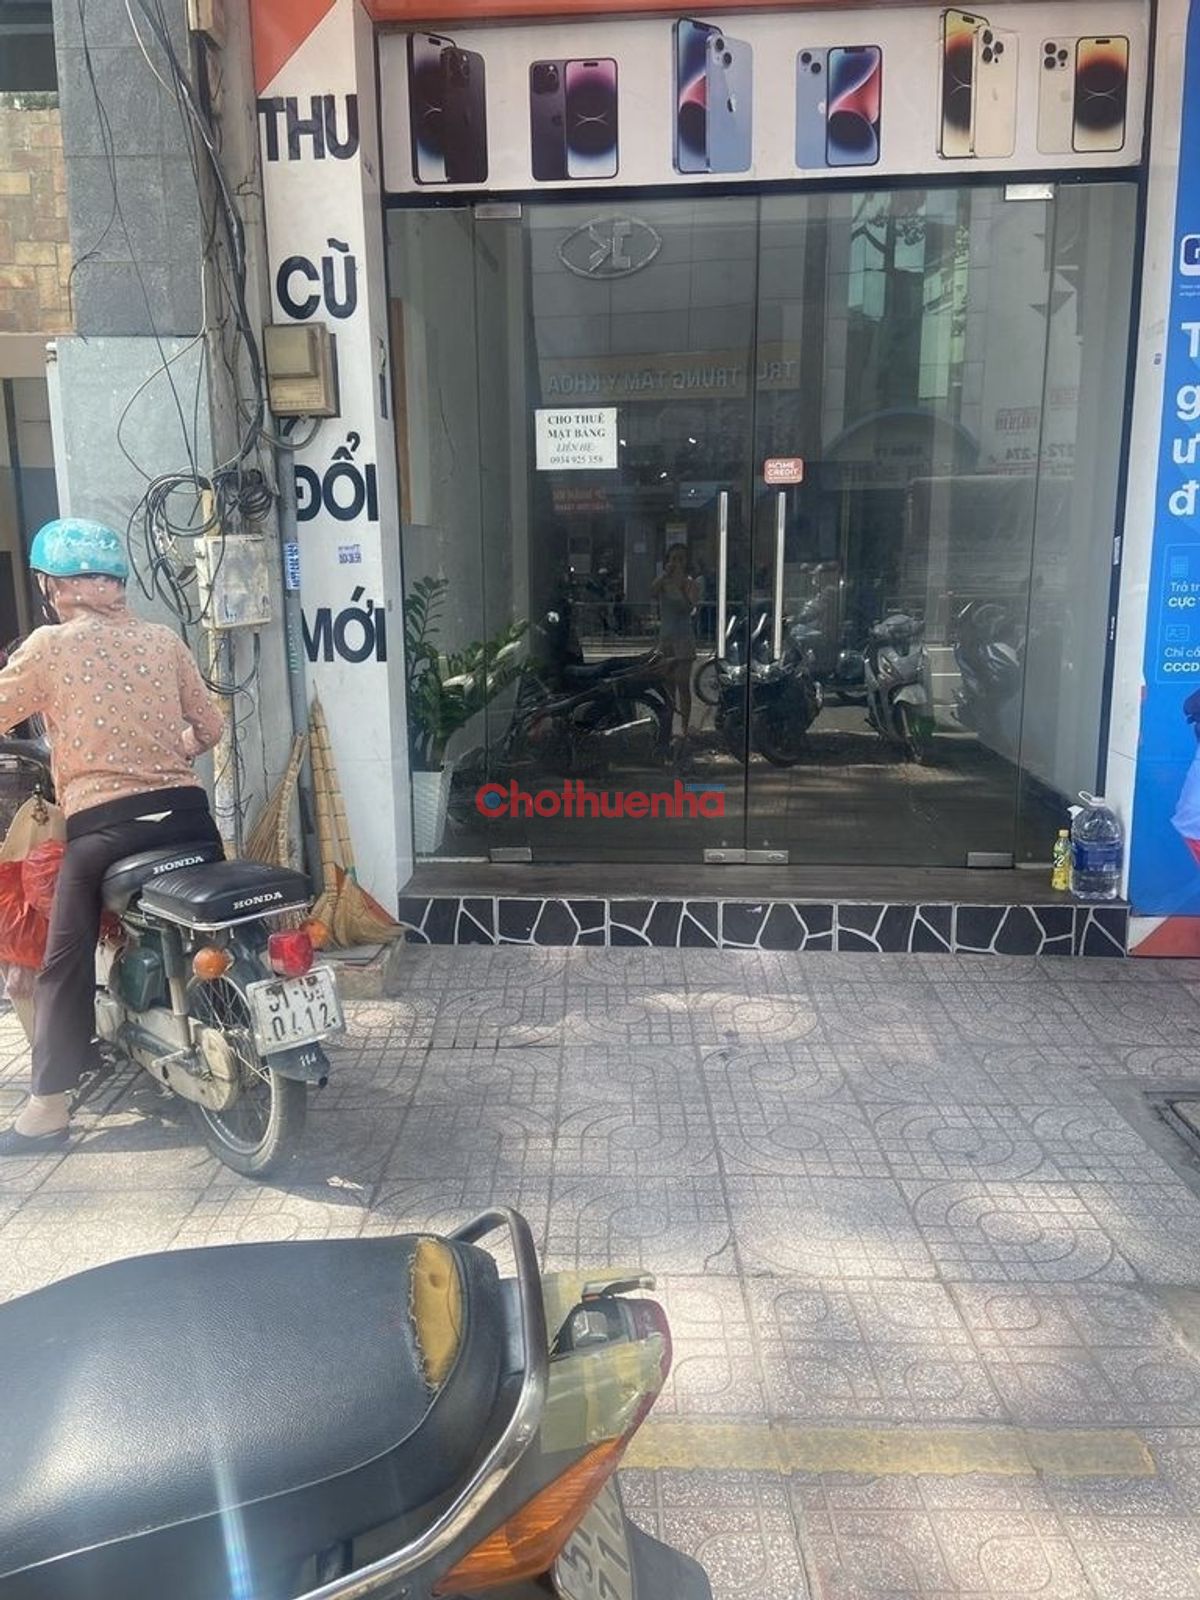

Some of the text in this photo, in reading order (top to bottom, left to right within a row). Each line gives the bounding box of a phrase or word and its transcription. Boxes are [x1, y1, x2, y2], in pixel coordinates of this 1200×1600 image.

[257, 94, 360, 161] THU
[276, 237, 357, 320] CŨ
[547, 415, 572, 425] CHO
[294, 431, 379, 522] ĐỔI
[300, 586, 387, 663] MỚI
[1163, 662, 1200, 672] CCCD
[153, 855, 204, 875] HONDA
[233, 891, 283, 910] HONDA
